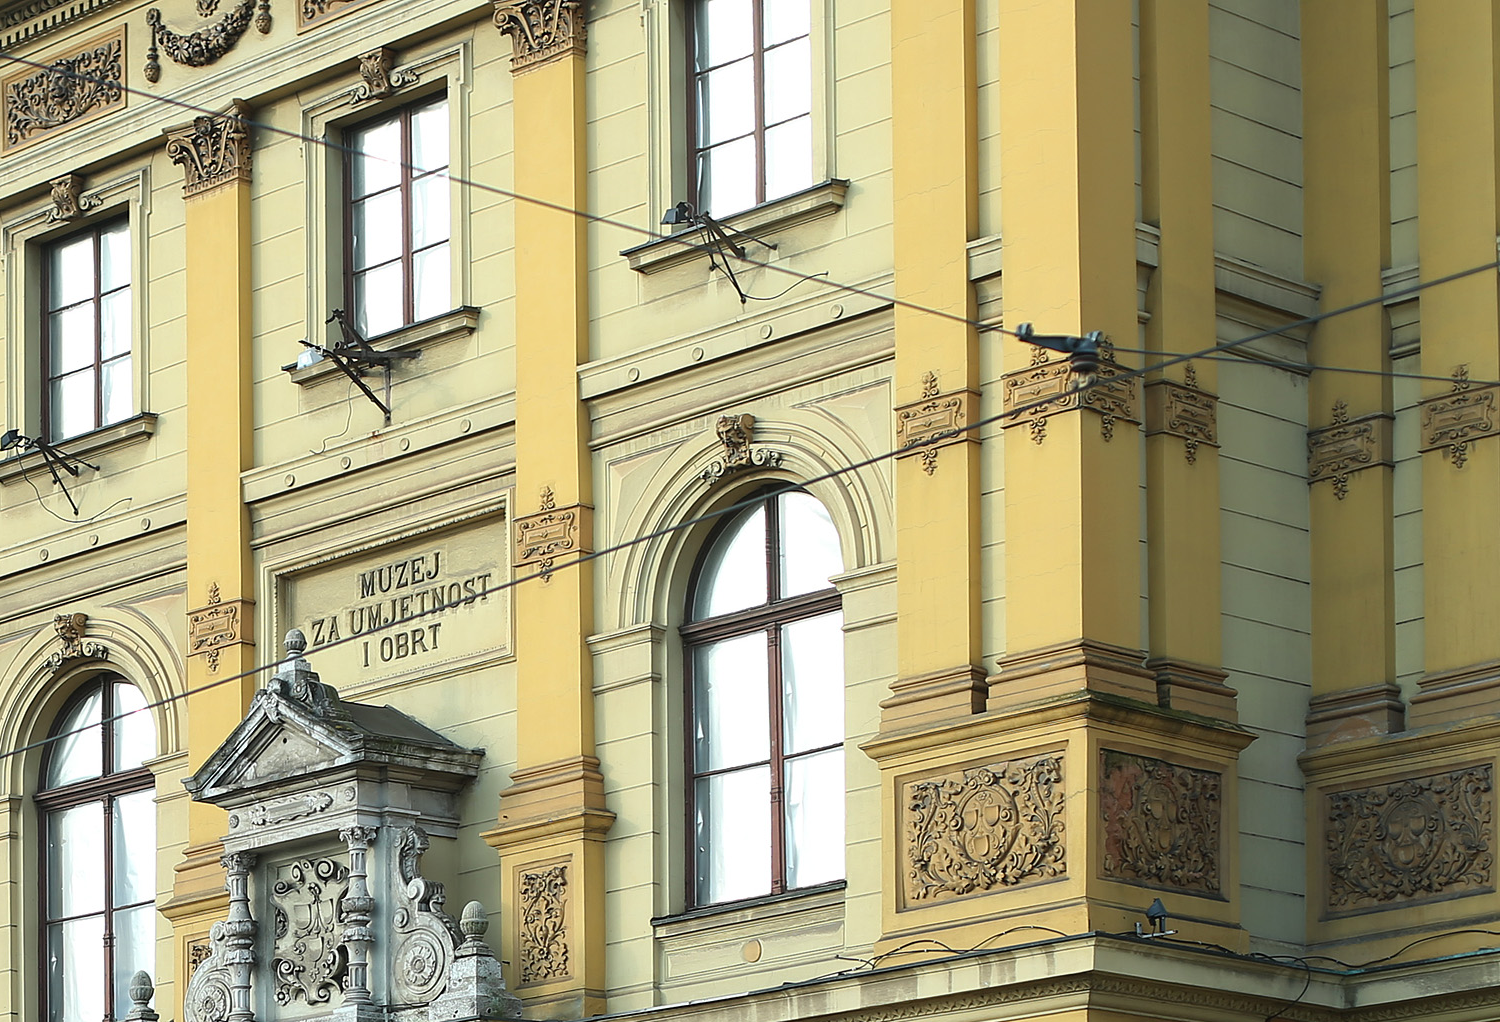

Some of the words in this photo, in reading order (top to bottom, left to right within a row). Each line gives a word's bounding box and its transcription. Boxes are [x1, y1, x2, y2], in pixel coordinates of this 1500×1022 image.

[360, 552, 441, 599] MUZEJ
[312, 615, 341, 647] ZA
[350, 573, 492, 635] UMJETNOST
[363, 641, 370, 668] I
[380, 622, 442, 663] OBRT
